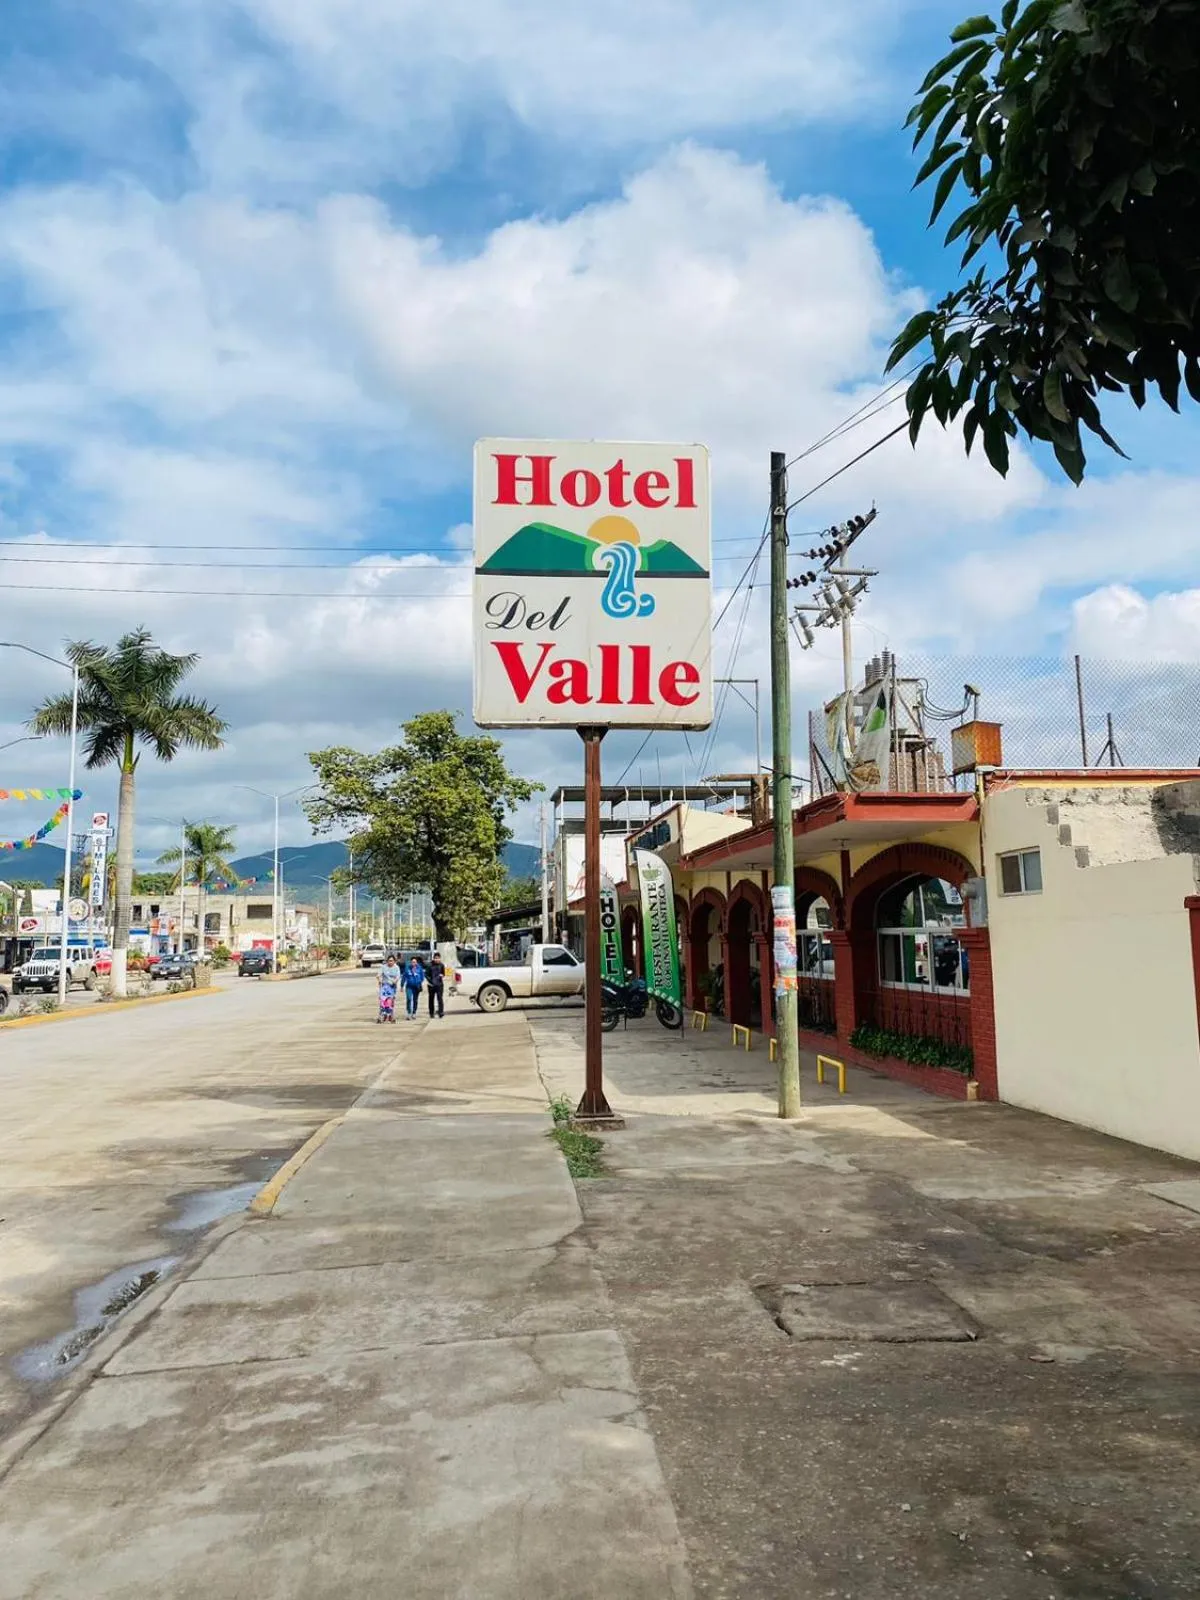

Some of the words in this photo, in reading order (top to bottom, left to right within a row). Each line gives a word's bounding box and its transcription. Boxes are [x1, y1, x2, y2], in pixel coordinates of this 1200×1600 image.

[490, 453, 698, 508] Hotel
[485, 591, 573, 631] Del
[490, 641, 701, 706] Valle
[601, 897, 618, 975] HOTEL
[647, 882, 662, 989] RESTAURANTE
